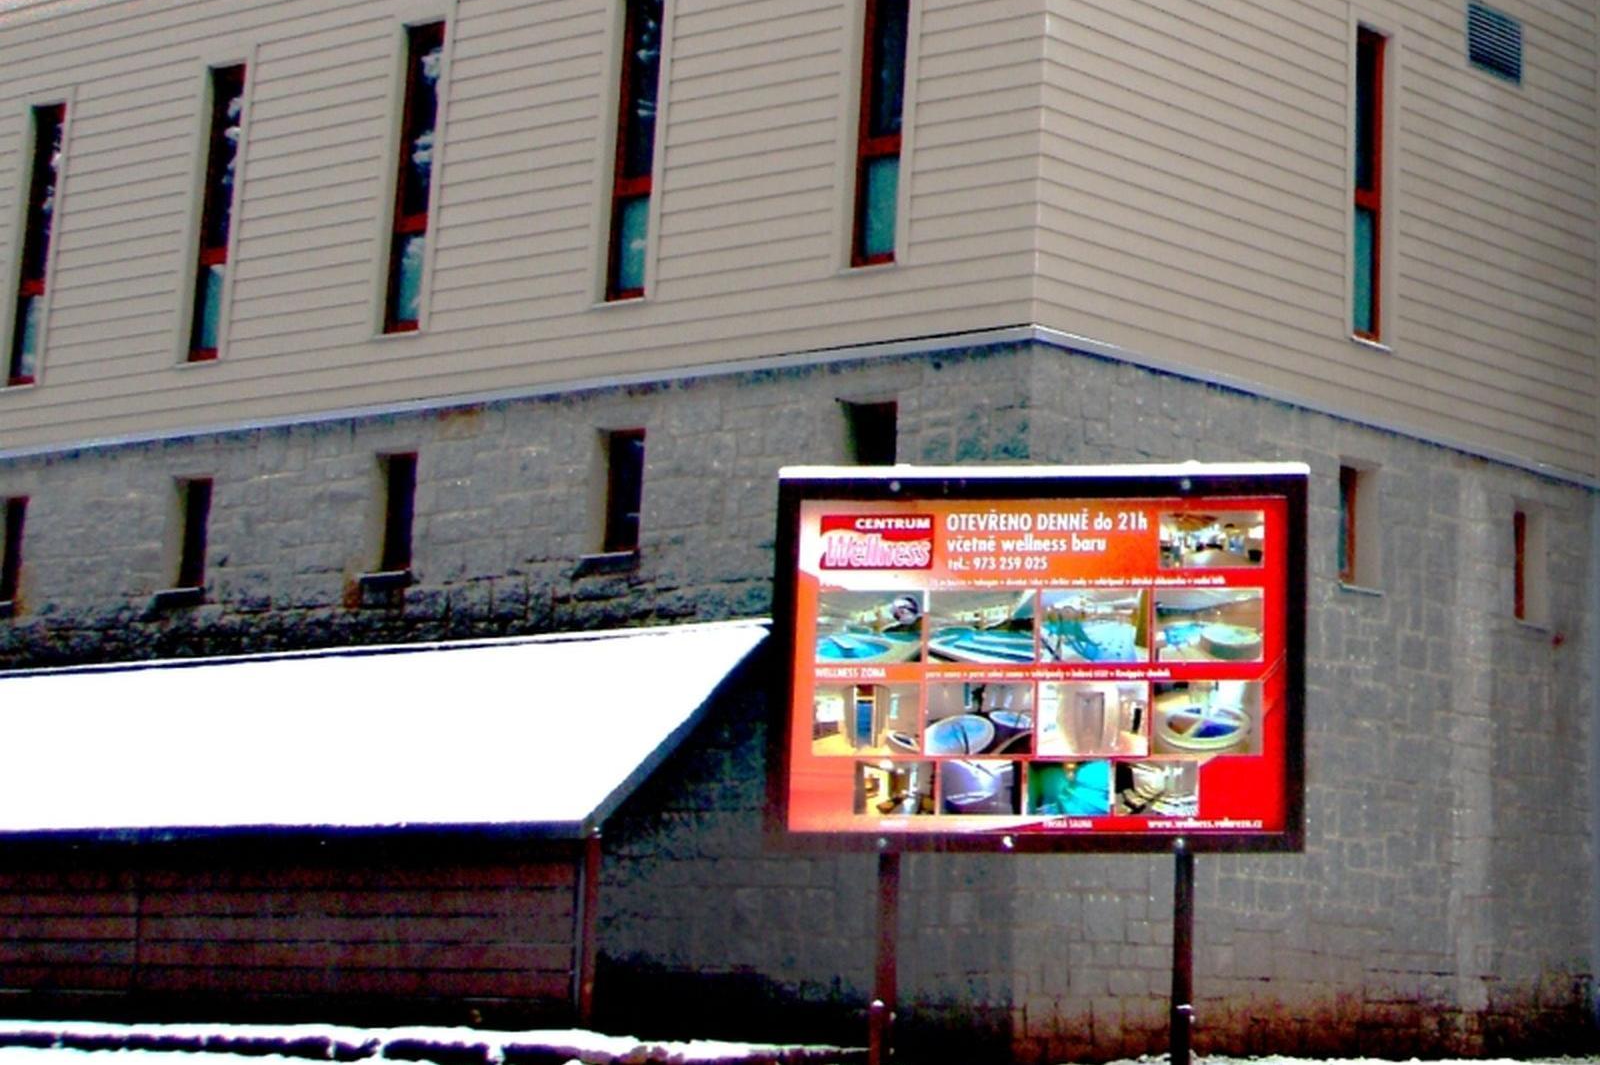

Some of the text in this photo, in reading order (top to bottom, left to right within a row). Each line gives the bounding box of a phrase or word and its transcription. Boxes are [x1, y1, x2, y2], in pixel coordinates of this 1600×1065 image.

[855, 518, 931, 530] CENTRUM
[946, 509, 1032, 531] OTEVŘENO
[1093, 512, 1113, 530] do
[1117, 512, 1149, 530] 21h
[825, 534, 932, 568] Wellness
[946, 533, 1107, 553] včetně wellness baru
[973, 556, 997, 570] 973
[999, 556, 1021, 571] 259
[1024, 556, 1049, 571] 025
